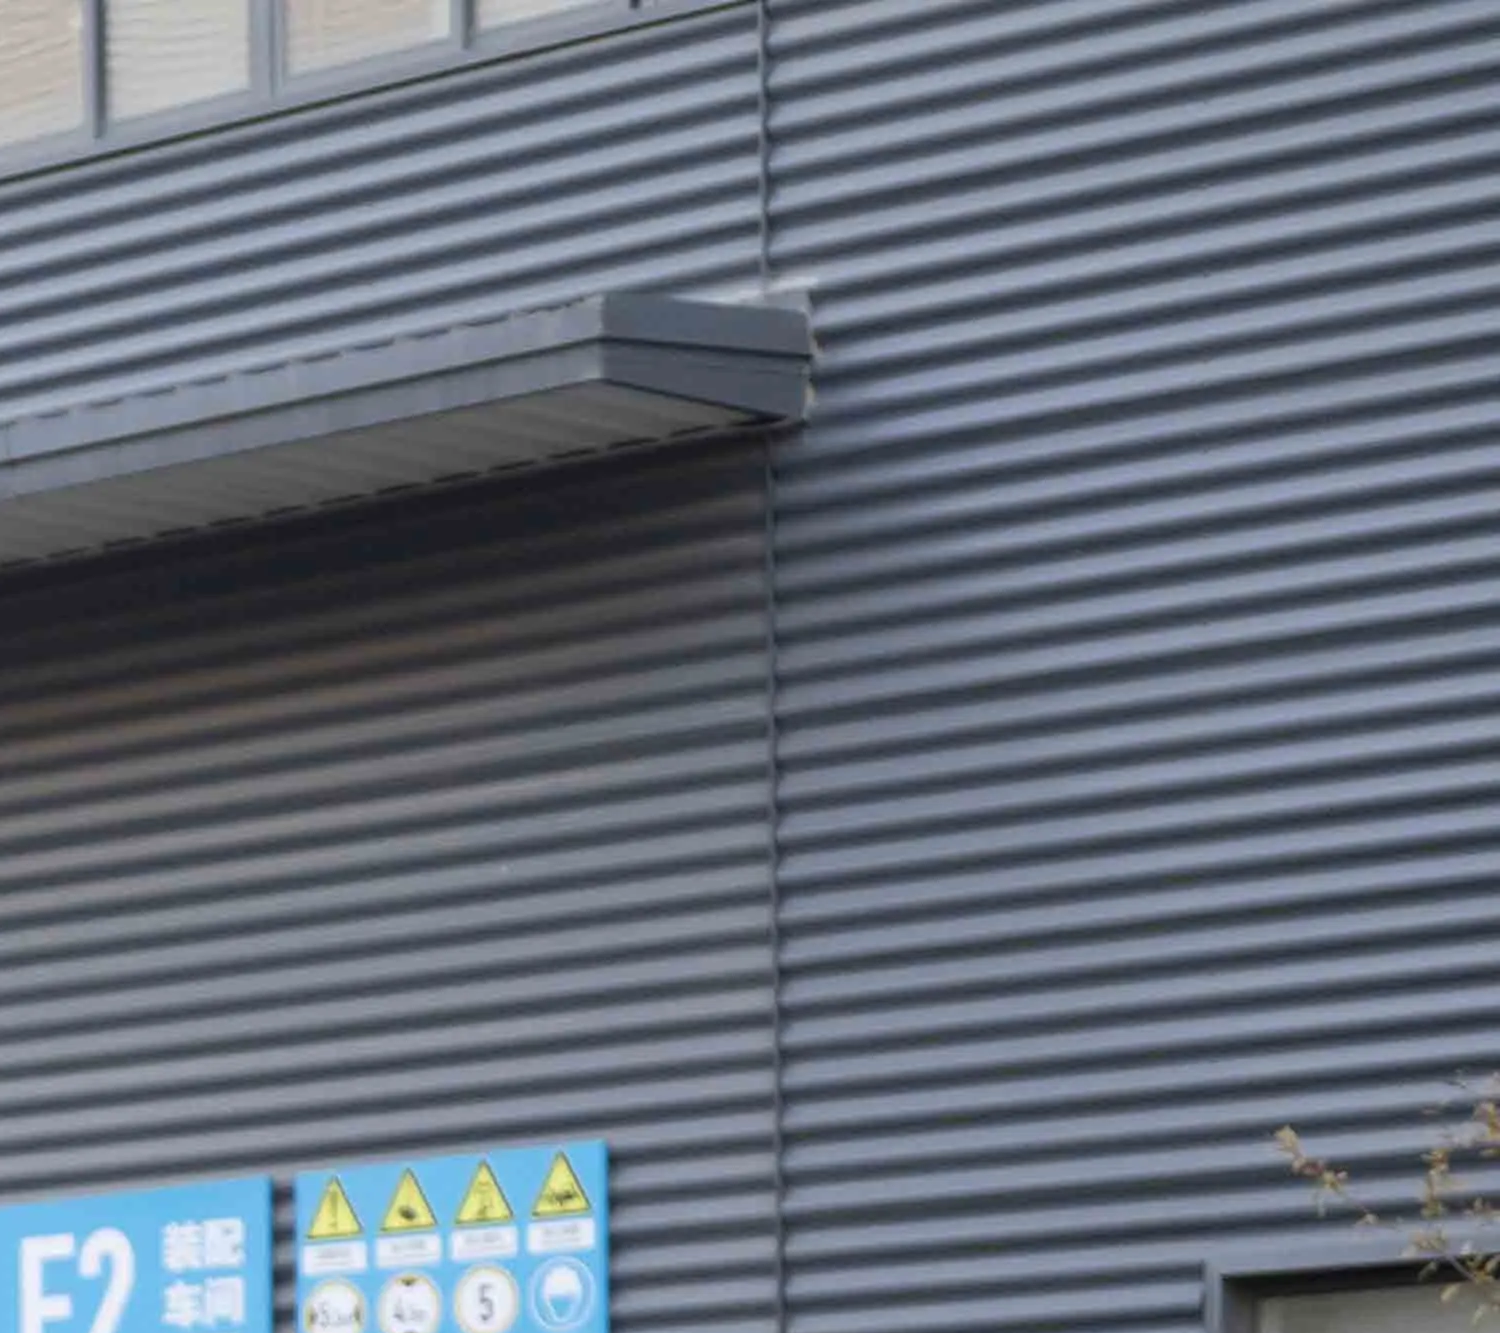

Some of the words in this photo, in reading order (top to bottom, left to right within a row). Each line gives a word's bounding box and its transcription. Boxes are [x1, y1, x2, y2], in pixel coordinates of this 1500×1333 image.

[162, 1217, 246, 1273] 装配
[162, 1276, 245, 1329] 车间
[478, 1283, 494, 1321] 5
